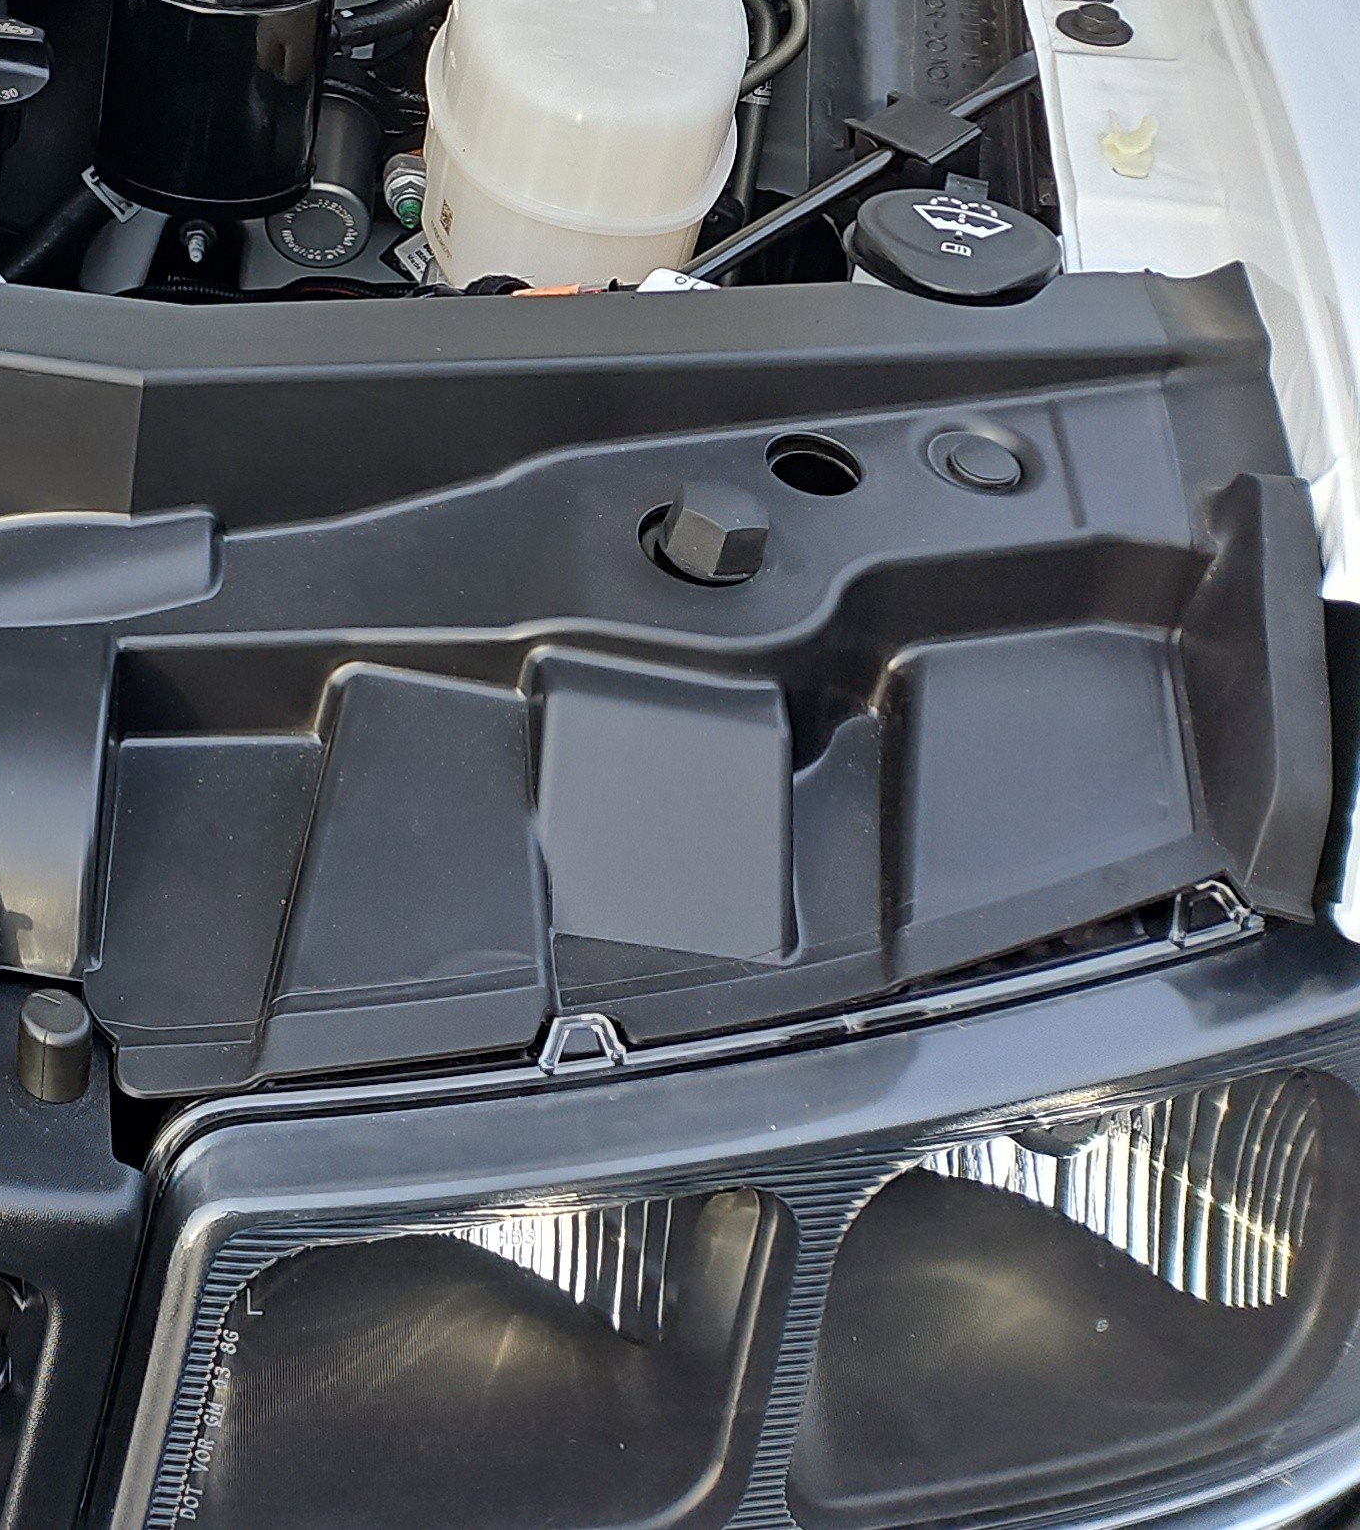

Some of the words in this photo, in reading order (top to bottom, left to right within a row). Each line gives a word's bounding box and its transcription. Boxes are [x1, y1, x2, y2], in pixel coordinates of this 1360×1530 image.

[203, 1402, 226, 1428] GM
[191, 1438, 215, 1473] VOR
[180, 1483, 205, 1521] DOT
